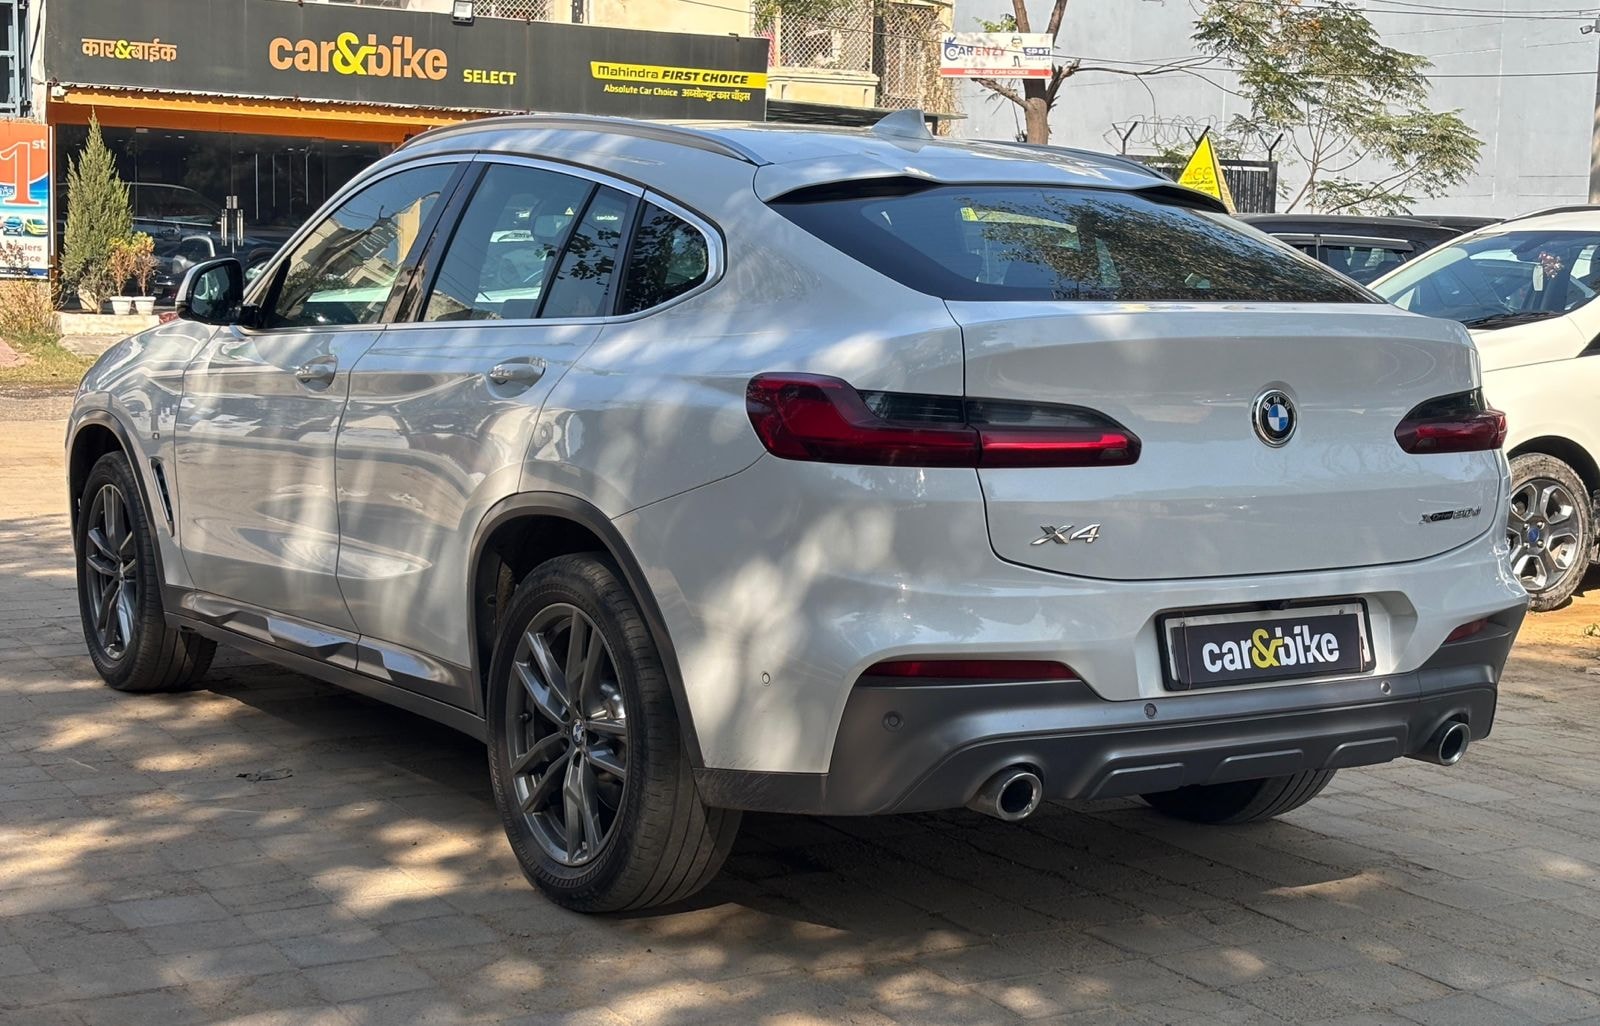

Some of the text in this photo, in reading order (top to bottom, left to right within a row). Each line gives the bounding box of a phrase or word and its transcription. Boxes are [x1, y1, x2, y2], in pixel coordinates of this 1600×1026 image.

[269, 32, 448, 80] car&bike
[463, 69, 517, 85] SELECT
[597, 65, 749, 85] Mahindra FIRST CHOICE
[604, 84, 679, 97] Absolute Car Choice
[1030, 524, 1100, 545] X4
[1202, 625, 1339, 673] car&bike
